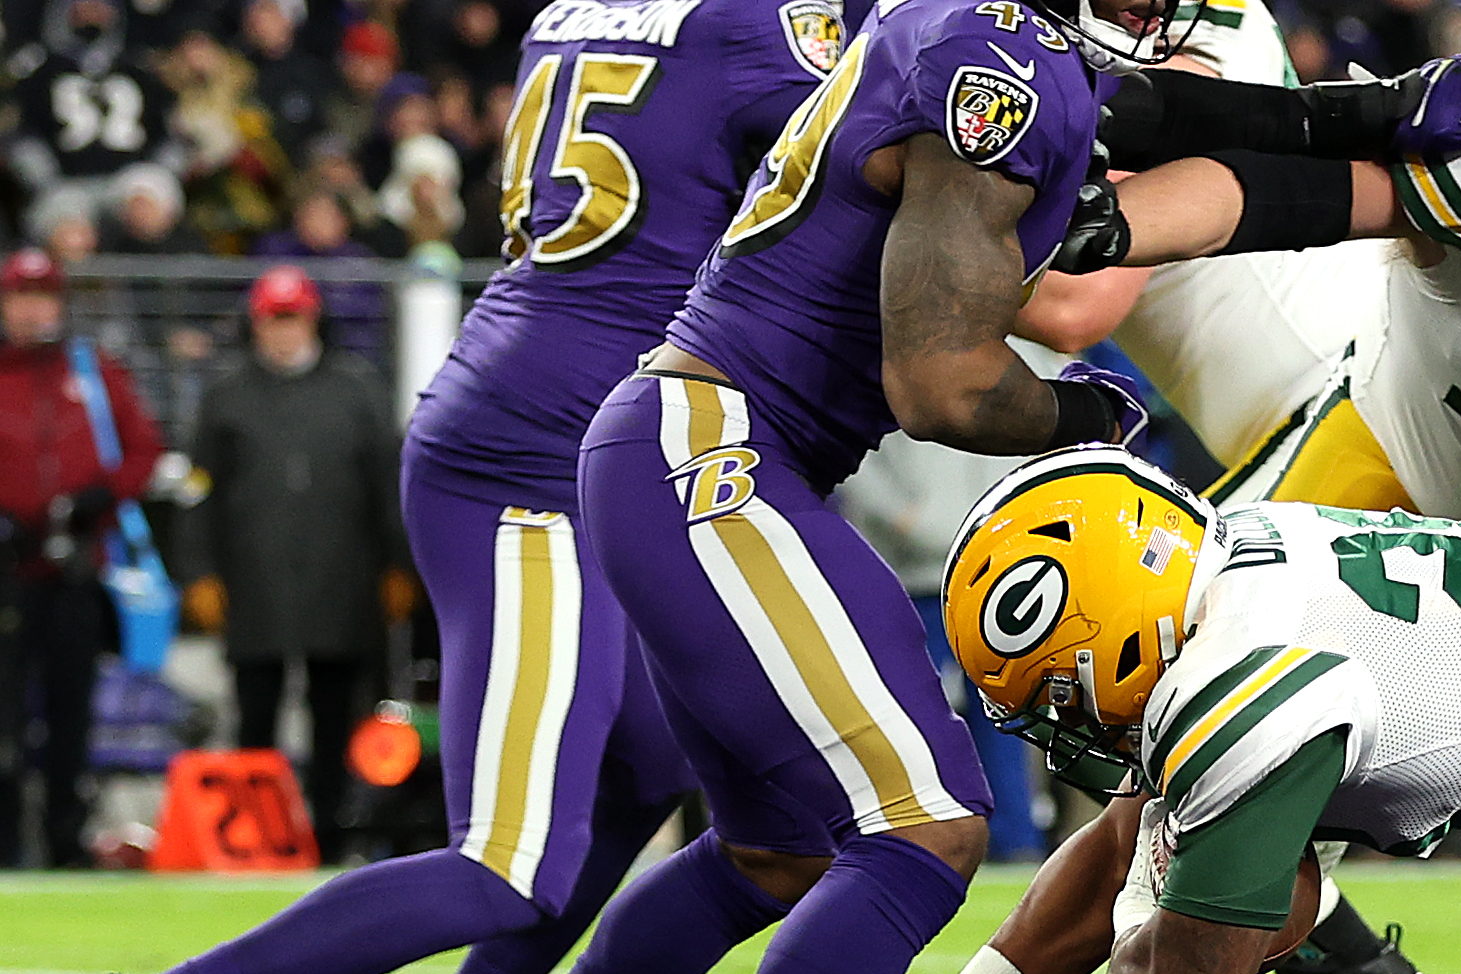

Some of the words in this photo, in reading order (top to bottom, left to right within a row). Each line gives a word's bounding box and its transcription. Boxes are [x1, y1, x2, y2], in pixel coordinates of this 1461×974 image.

[965, 74, 1029, 104] RAVENS
[499, 52, 664, 268] 45
[664, 446, 761, 522] B
[981, 558, 1066, 656] G
